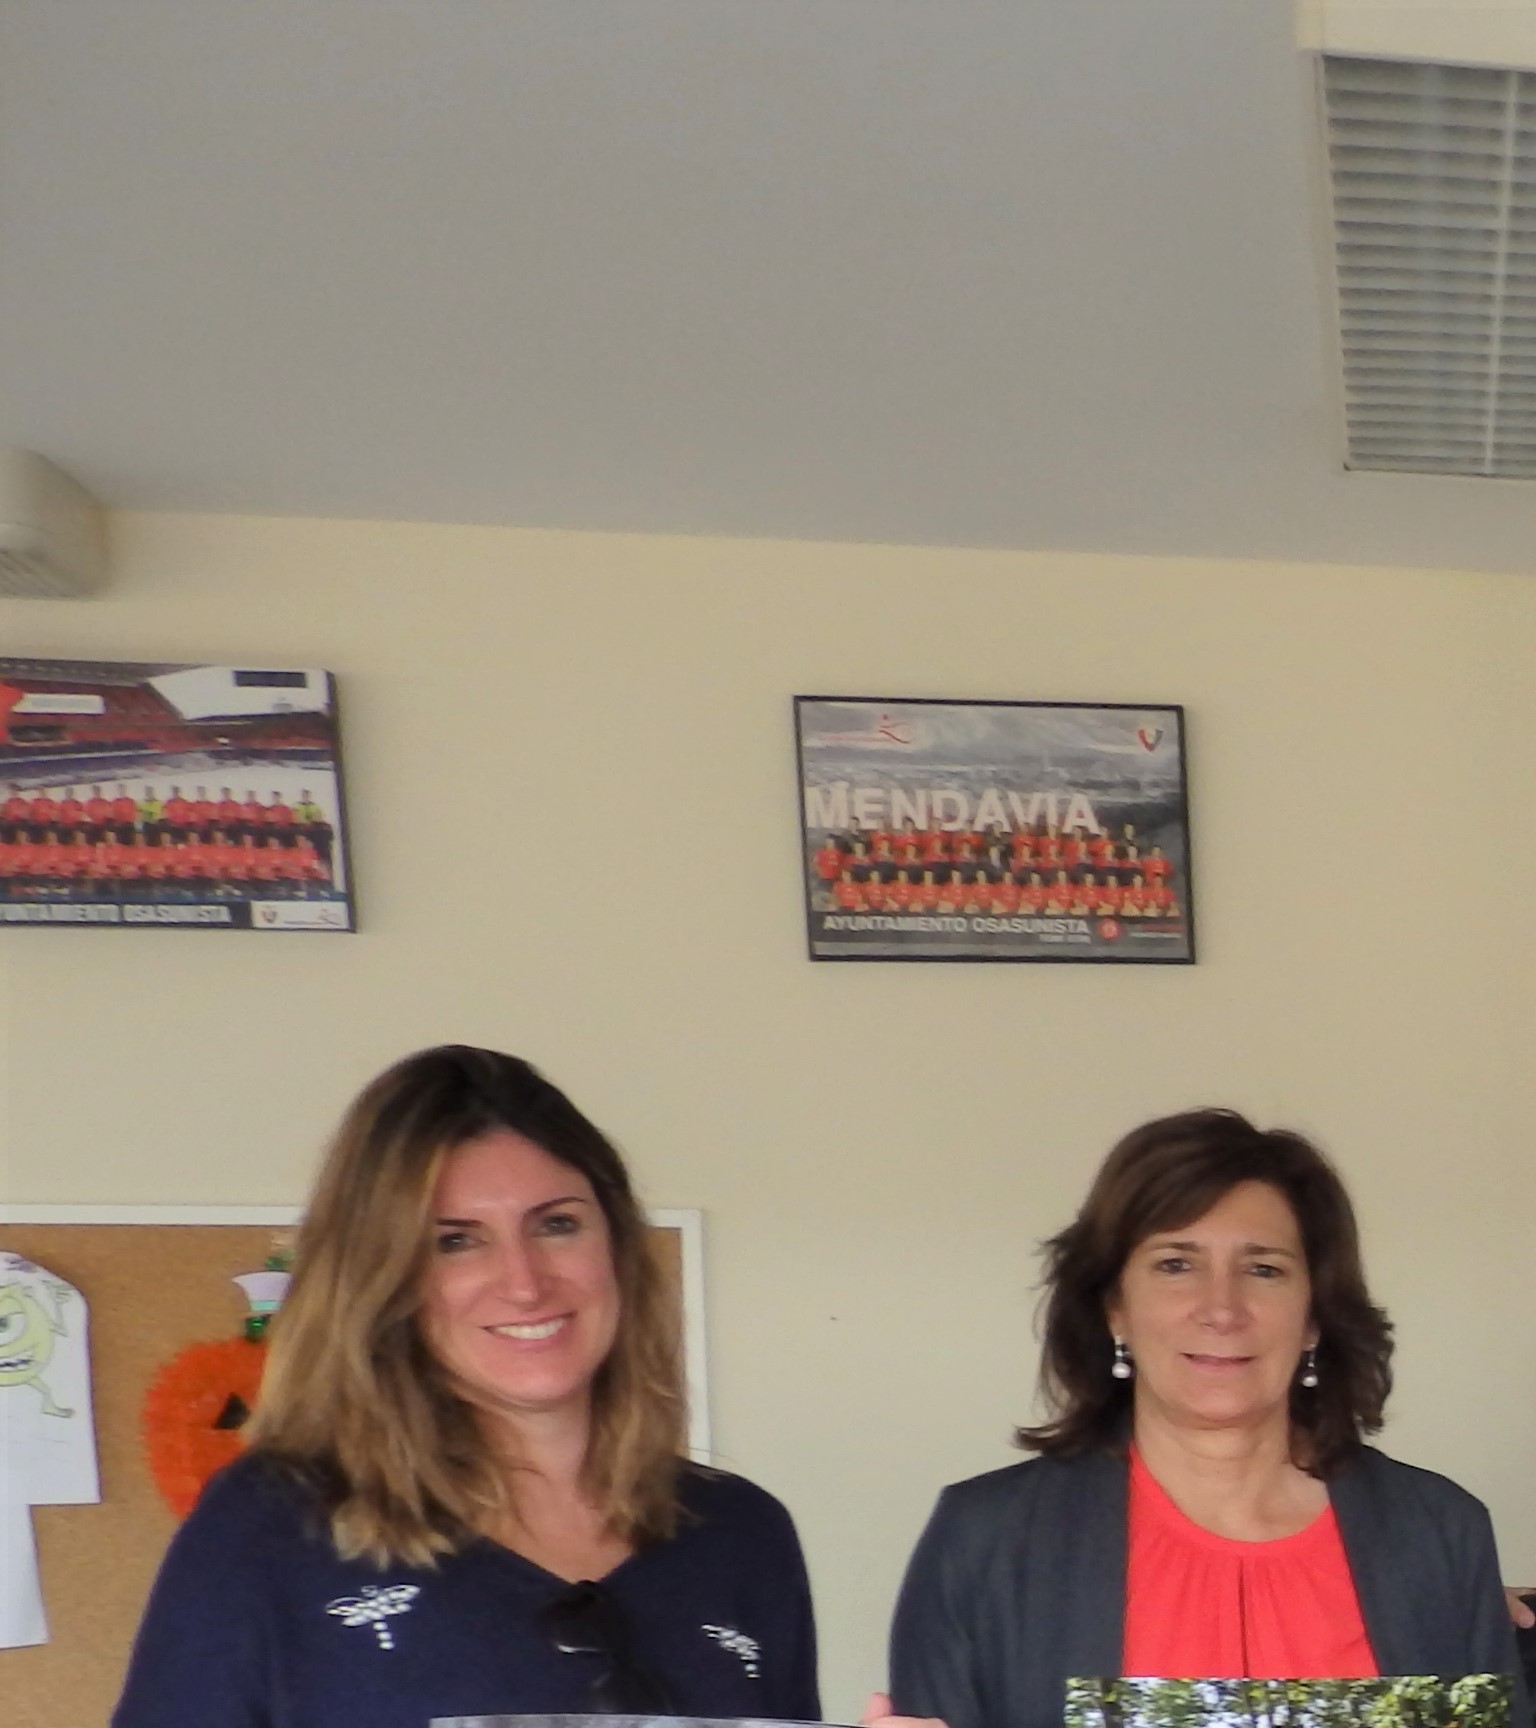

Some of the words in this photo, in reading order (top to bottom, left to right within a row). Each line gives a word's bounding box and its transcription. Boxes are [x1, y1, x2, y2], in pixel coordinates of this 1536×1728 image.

[804, 784, 1101, 834] MENDAVIA
[823, 914, 967, 932] AYUNTAMIENTO
[972, 916, 1090, 934] OSASUNISTA
